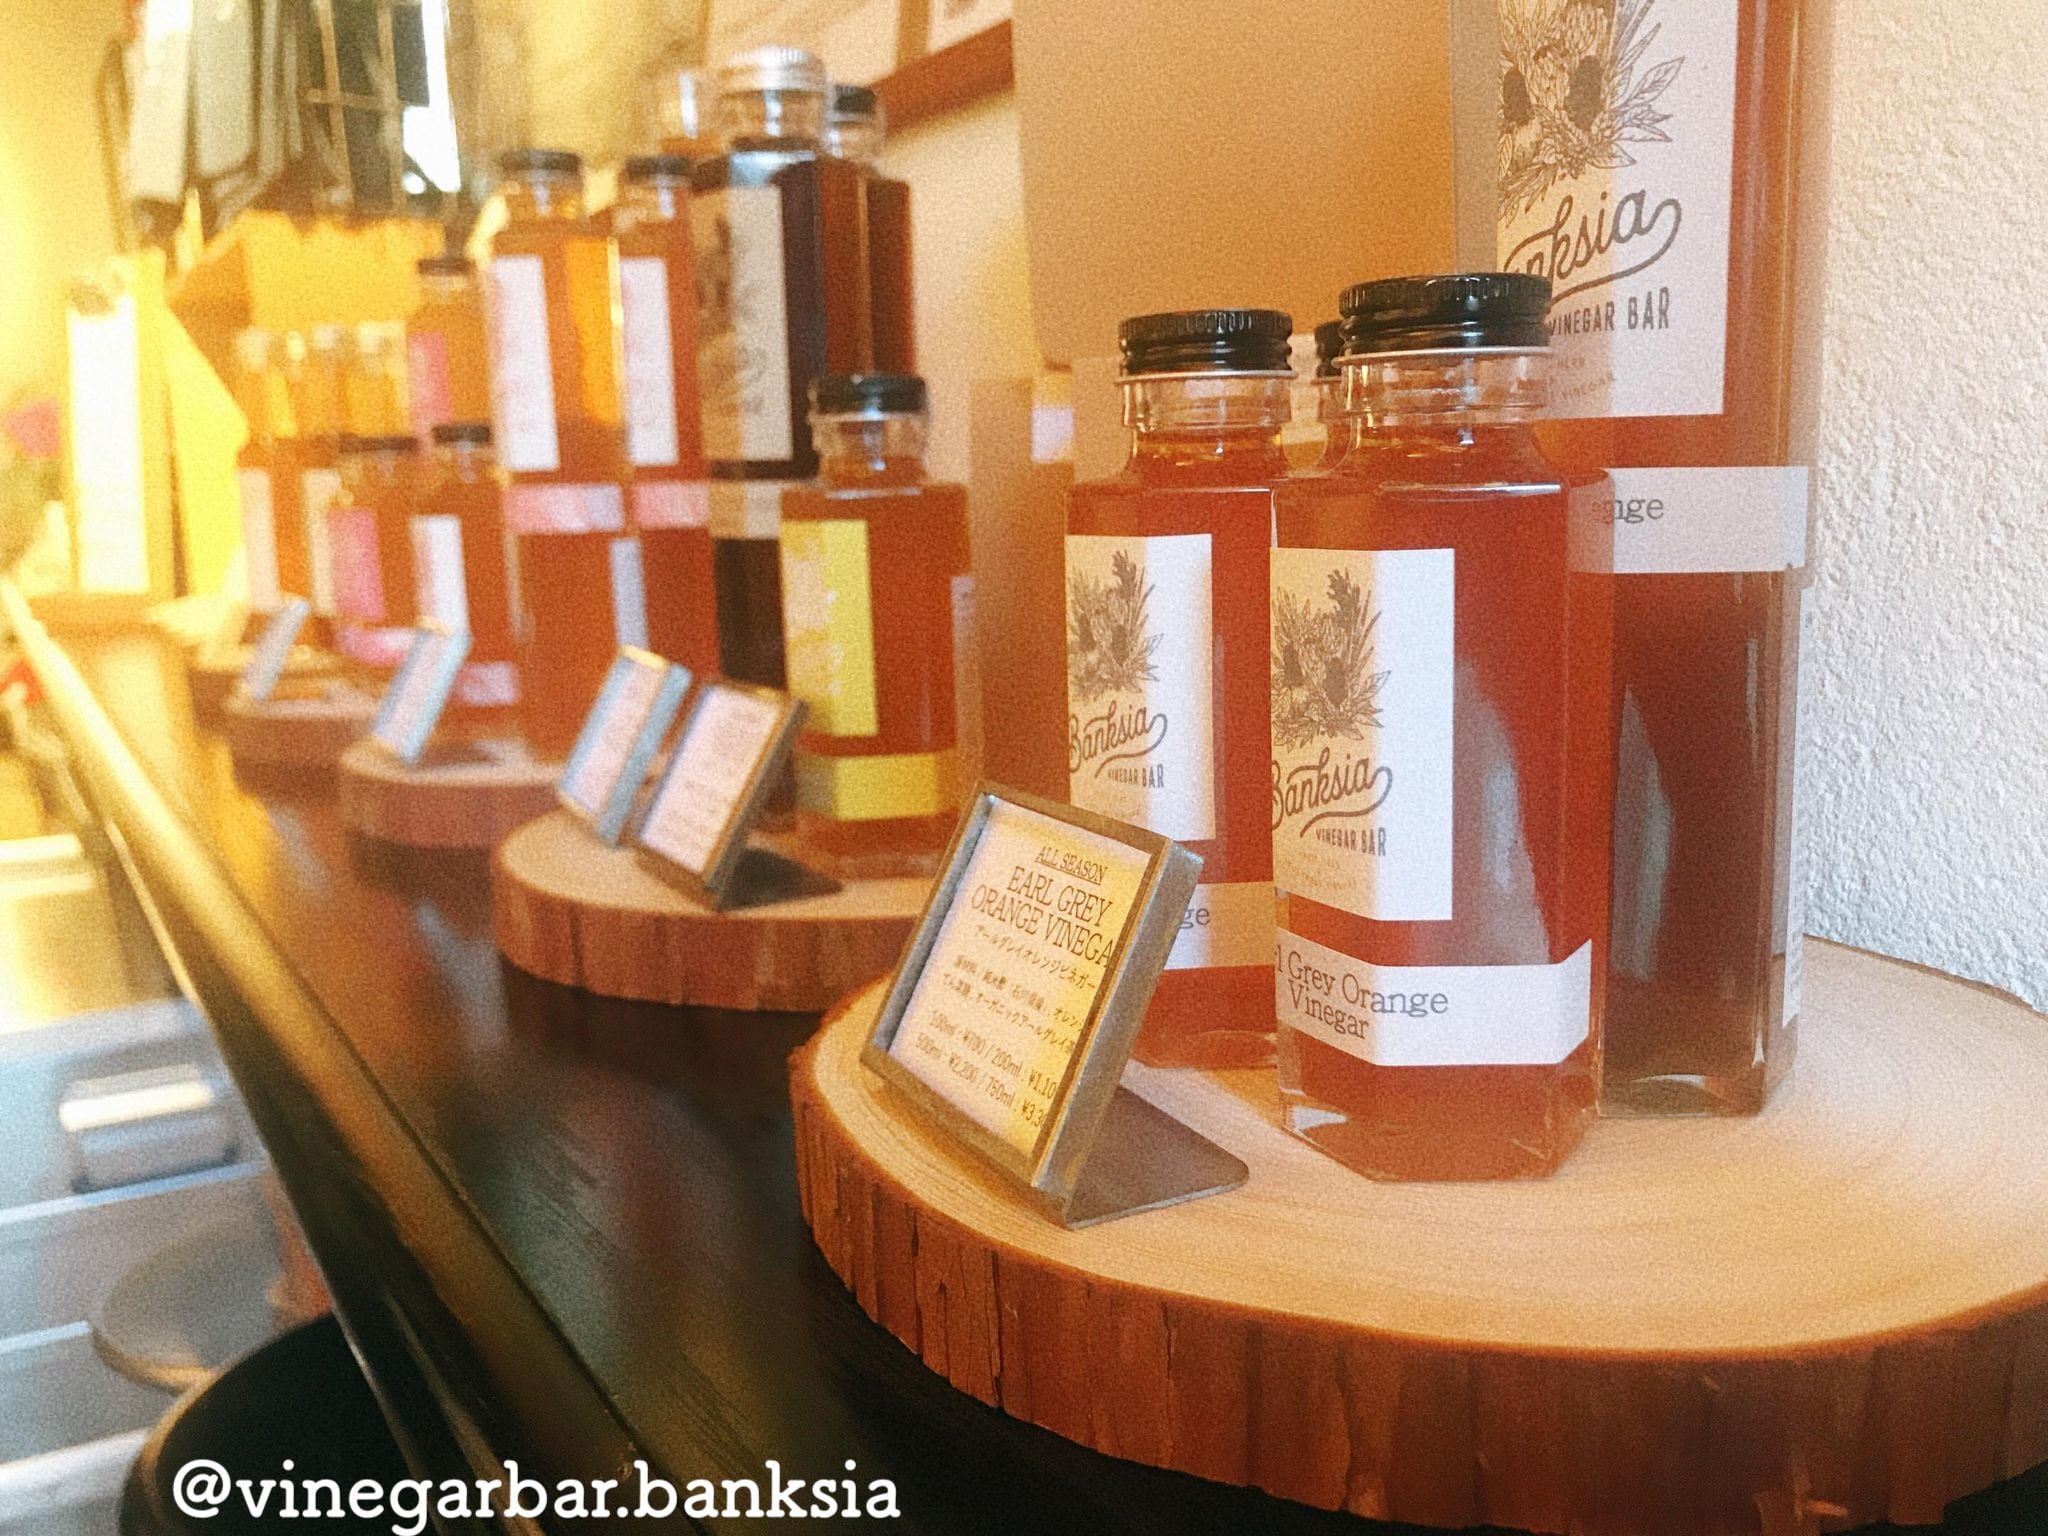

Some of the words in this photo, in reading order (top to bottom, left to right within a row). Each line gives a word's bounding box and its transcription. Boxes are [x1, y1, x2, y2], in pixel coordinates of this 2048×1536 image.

[1504, 189, 1682, 313] nksia
[1548, 301, 1615, 336] VINEGAR
[1628, 287, 1670, 330] BAR
[1069, 700, 1168, 778] Banksia
[1142, 763, 1164, 788] BAR
[1035, 845, 1060, 867] ALL
[1059, 852, 1108, 883] SEASON
[1316, 828, 1356, 851] VINEGAR
[1362, 827, 1386, 856] BAR
[1006, 865, 1054, 906] EARL
[1057, 884, 1114, 929] GREY
[970, 883, 1045, 936] ORANGE
[1044, 917, 1116, 969] VINEGA
[1288, 950, 1336, 997] Grey
[1342, 973, 1449, 1018] Orange
[1288, 979, 1370, 1040] Vinegar
[990, 1047, 1023, 1078] 200ml
[985, 1076, 1016, 1109] 750ml
